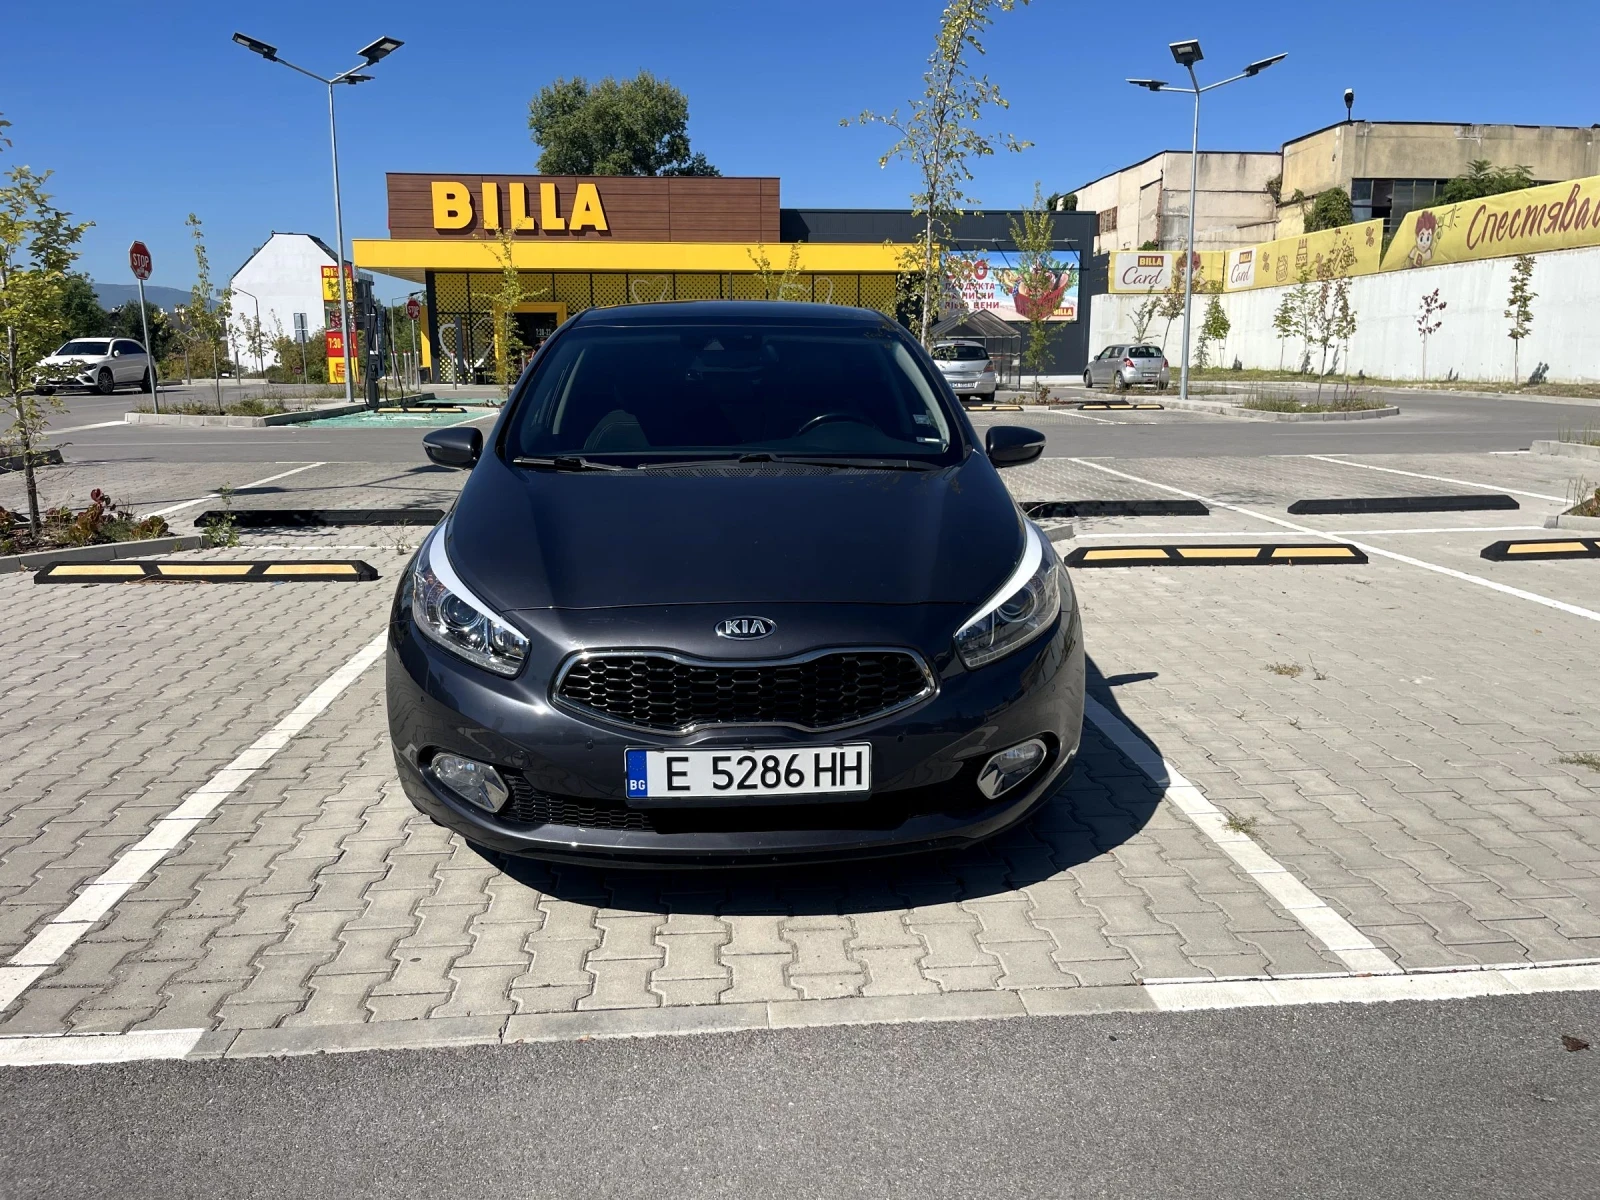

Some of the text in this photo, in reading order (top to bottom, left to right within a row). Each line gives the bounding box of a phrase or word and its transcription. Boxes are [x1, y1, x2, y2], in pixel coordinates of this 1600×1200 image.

[431, 181, 608, 231] BILLA
[132, 253, 149, 267] STOP
[1139, 257, 1163, 266] BILLA
[1122, 266, 1164, 285] Card
[1230, 263, 1251, 284] Card
[973, 301, 1000, 310] ЦЕНИ
[725, 619, 766, 634] KIA
[666, 751, 862, 791] E 5286 HH
[629, 779, 646, 791] BG
